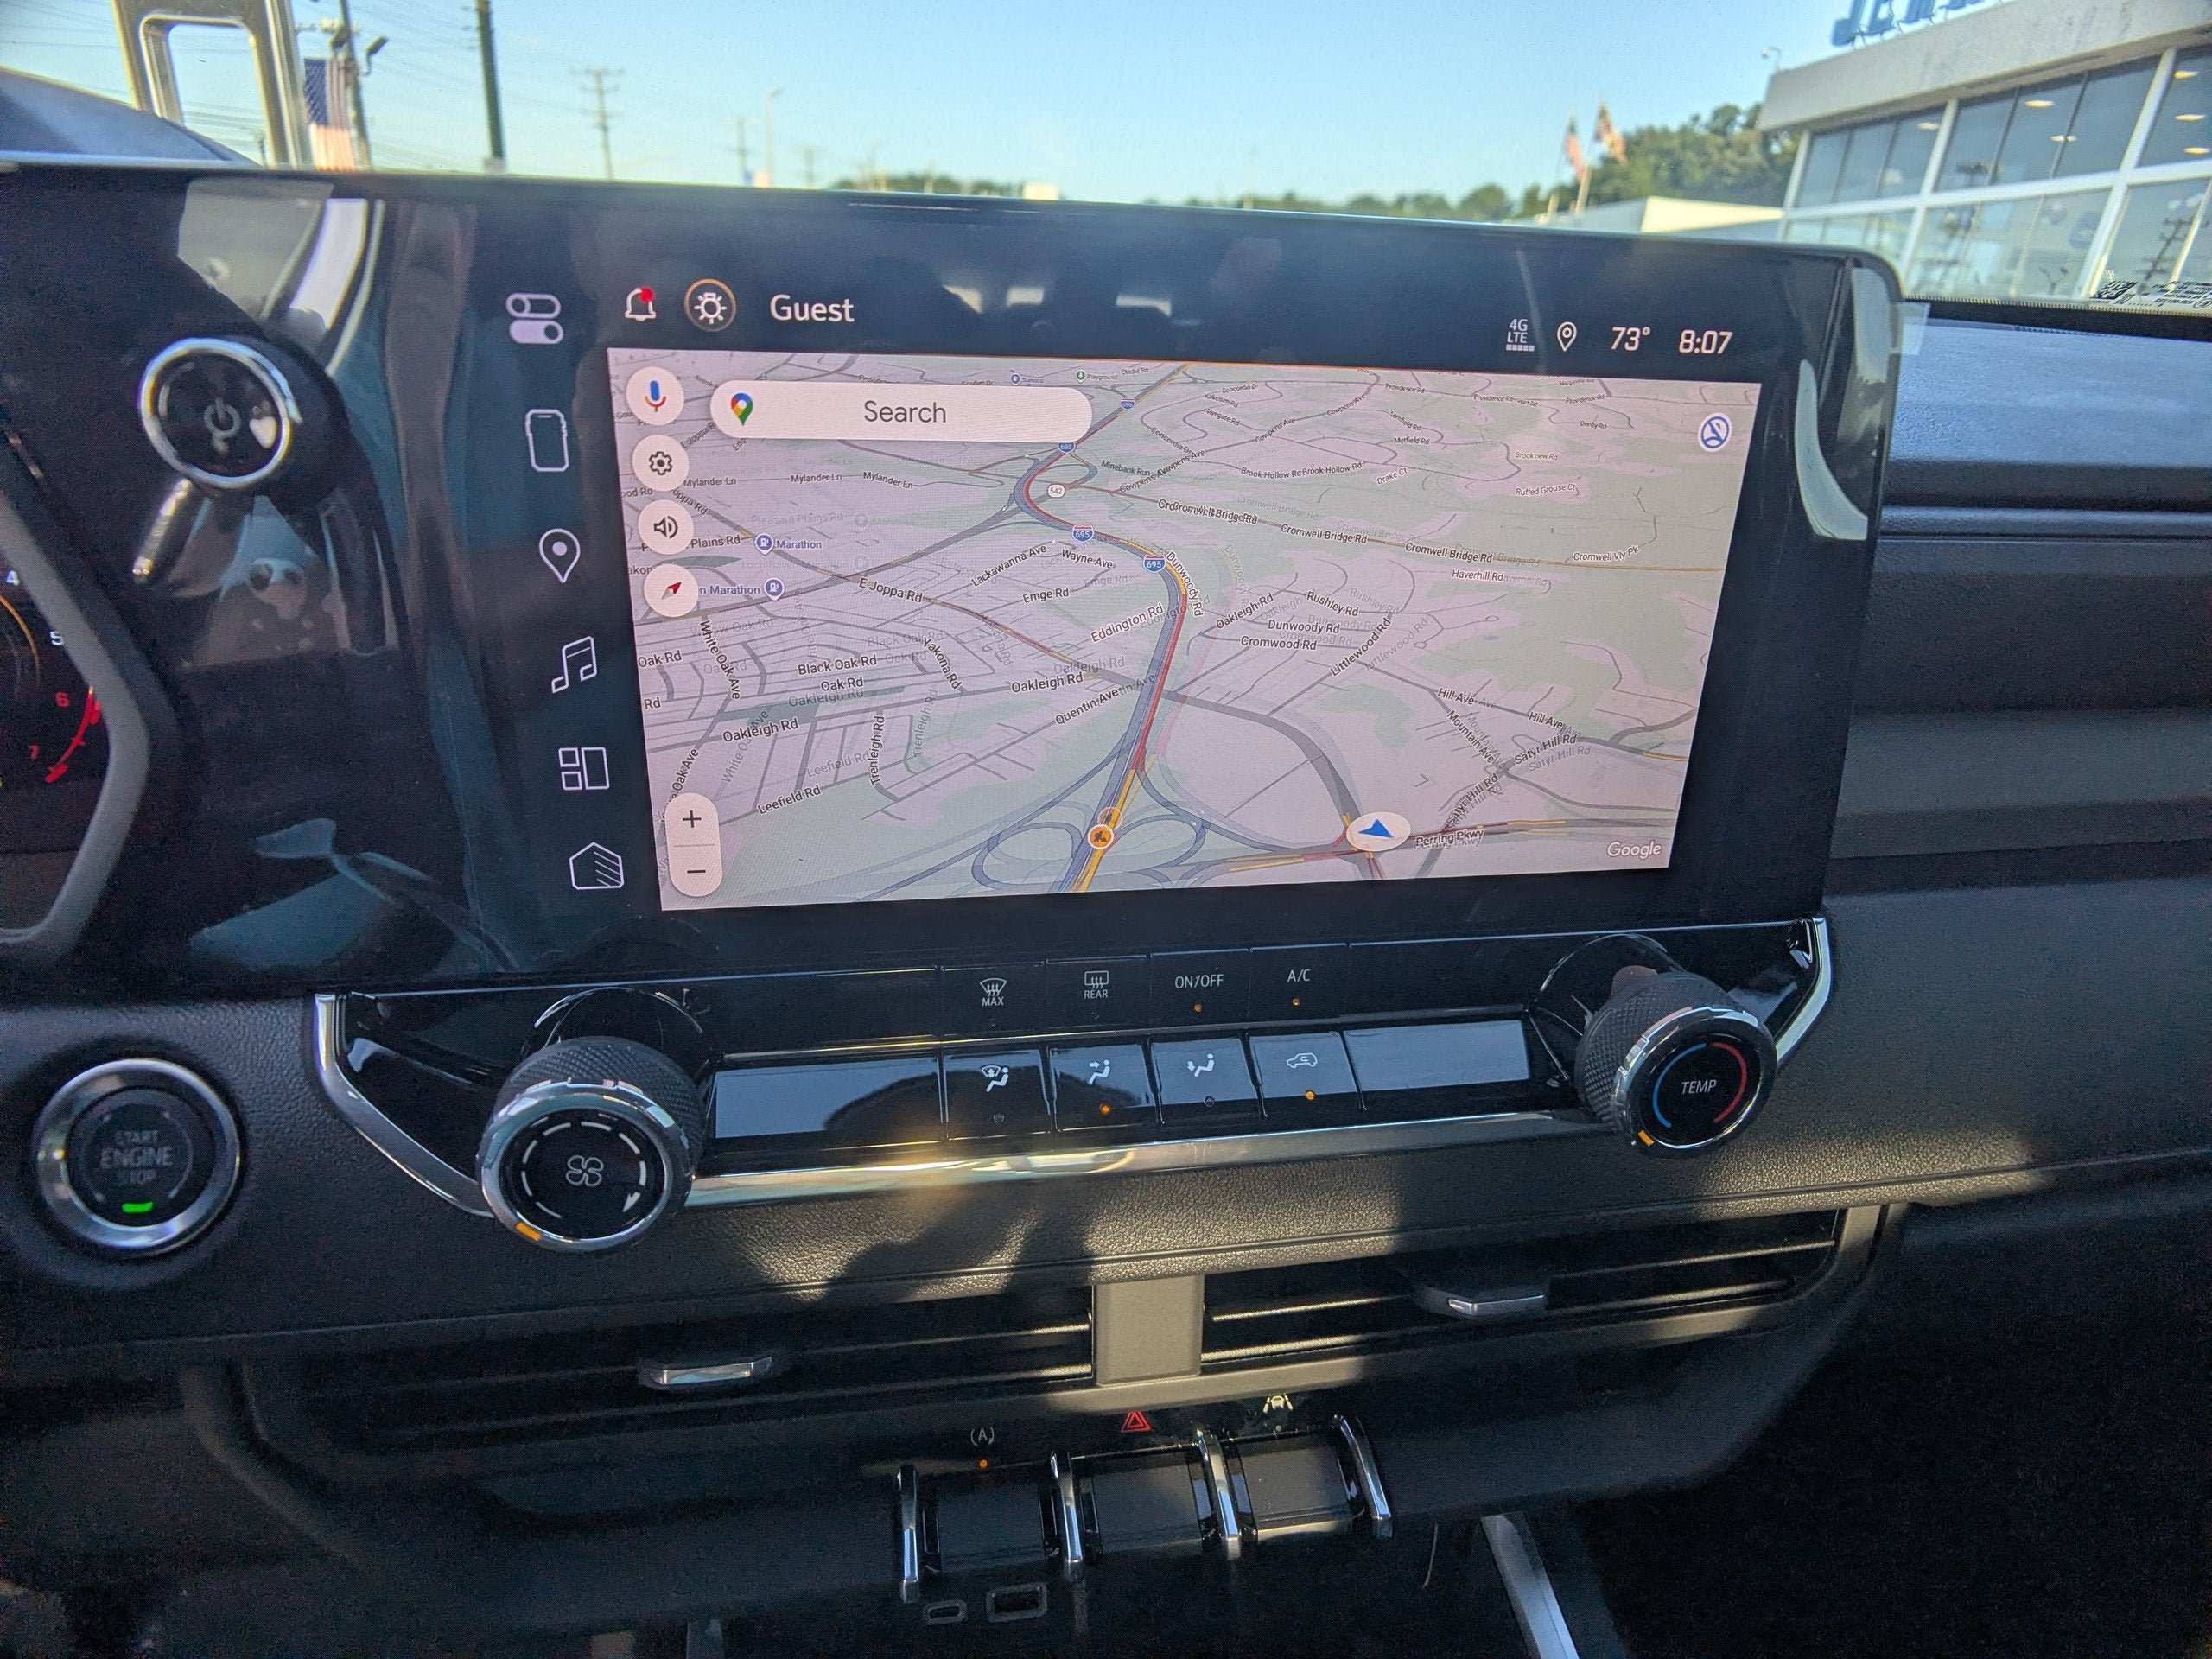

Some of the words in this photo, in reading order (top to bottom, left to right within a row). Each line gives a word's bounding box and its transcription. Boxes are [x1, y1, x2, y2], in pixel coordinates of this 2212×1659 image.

[770, 294, 855, 322] Guest
[1510, 319, 1528, 331] 4G
[1507, 332, 1527, 343] LTE
[1611, 327, 1650, 351] 73°
[1679, 330, 1732, 354] 8:07
[864, 400, 946, 423] Search
[1327, 399, 1354, 416] Cowpens
[1354, 394, 1367, 404] Ave
[1230, 417, 1240, 426] Rd
[1255, 423, 1283, 443] Cowpens
[1283, 417, 1297, 426] Ave
[1191, 449, 1205, 461] Ave
[1101, 460, 1135, 474] Minebank
[1136, 466, 1151, 476] Run
[1241, 467, 1262, 478] Brook
[1264, 469, 1290, 479] Hollow
[1291, 468, 1301, 477] Rd
[1302, 466, 1324, 476] Brook
[1325, 463, 1351, 474] Hollow
[1352, 461, 1363, 470] Rd
[1376, 473, 1397, 486] Drake
[1398, 467, 1408, 476] Ct
[683, 479, 722, 489] Mylander
[724, 477, 737, 486] Ln
[791, 473, 829, 484] Mylander
[830, 473, 843, 481] Ln
[863, 472, 902, 487] Mylander
[903, 480, 914, 489] Ln
[1120, 474, 1157, 493] Cowpens
[1049, 486, 1063, 495] 542
[1516, 486, 1540, 497] Ruffed
[1541, 484, 1567, 494] Grouse
[1567, 482, 1577, 492] Ct
[694, 499, 709, 514] Rd
[691, 537, 724, 549] Plains
[726, 535, 741, 545] Rd
[1281, 524, 1323, 539] Cromwell
[1324, 529, 1353, 543] Bridge
[1354, 532, 1368, 544] Rd
[777, 540, 822, 550] Marathon
[1405, 543, 1448, 558] Cromwell
[1449, 546, 1479, 563] Bridge
[1479, 551, 1493, 563] Rd
[1573, 552, 1611, 562] Cromwell
[1627, 546, 1640, 557] Pk
[971, 552, 1027, 588] Lackawanna
[1027, 545, 1047, 559] Ave
[1061, 548, 1093, 567] Wayne
[1094, 556, 1114, 571] Ave
[7, 570, 20, 586] 4
[1166, 551, 1198, 604] Dunwoody
[1192, 601, 1204, 617] Rd
[1451, 569, 1491, 582] Haverhill
[1491, 570, 1504, 582] Rd
[709, 585, 760, 595] Marathon
[859, 577, 868, 589] E
[868, 580, 906, 600] Joppa
[906, 590, 924, 603] Rd
[1023, 588, 1053, 604] Emge
[1054, 587, 1070, 599] Rd
[1216, 601, 1259, 629] Oakleigh
[1259, 592, 1274, 607] Rd
[1306, 590, 1343, 615] Rushley
[1344, 604, 1359, 617] Rd
[1090, 612, 1147, 643] Eddington
[1147, 602, 1164, 618] Rd
[1268, 619, 1324, 634] Dunwoody
[1325, 624, 1340, 634] Rd
[49, 631, 64, 645] 5
[1241, 635, 1300, 650] Cromwood
[1302, 639, 1317, 651] Rd
[1331, 632, 1379, 677] Littlewood
[1376, 617, 1392, 634] Rd
[638, 655, 664, 668] Oak
[664, 650, 682, 664] Rd
[700, 620, 719, 654] White
[716, 653, 734, 677] Oak
[728, 677, 741, 701] Ave
[798, 661, 831, 675] Black
[834, 658, 860, 671] Oak
[861, 654, 878, 668] Rd
[923, 638, 951, 678] Yakona
[946, 673, 963, 690] Rd
[821, 679, 845, 692] Oak
[847, 676, 864, 689] Rd
[1011, 677, 1065, 694] Oakleigh
[1066, 671, 1084, 685] Rd
[55, 692, 70, 708] 6
[644, 697, 661, 709] Rd
[1438, 687, 1454, 701] Hill
[1454, 693, 1475, 706] Ave
[1055, 698, 1098, 725] Quentin
[1098, 688, 1120, 705] Ave
[722, 721, 779, 743] Oakleigh
[779, 717, 800, 732] Rd
[874, 715, 886, 733] Rd
[1529, 711, 1545, 725] Hill
[1545, 716, 1564, 730] Ave
[1448, 709, 1481, 749] Mountain
[1478, 746, 1495, 765] Ave
[869, 732, 883, 787] Trenleigh
[1515, 747, 1542, 766] Satyr
[1542, 736, 1561, 751] Hill
[1561, 734, 1579, 746] Rd
[672, 767, 690, 792] Oak
[682, 748, 701, 771] Ave
[758, 790, 804, 815] Leefield
[804, 784, 822, 798] Rd
[1446, 796, 1469, 826] Satyr
[1466, 782, 1485, 803] Hill
[1484, 772, 1500, 789] Rd
[1415, 834, 1456, 849] Perring
[1456, 829, 1485, 842] Pkwy
[1607, 841, 1662, 860] Google
[1175, 974, 1224, 989] ON/OFF
[1287, 969, 1312, 983] A/C
[982, 996, 1005, 1007] MAX
[1084, 989, 1109, 1000] REAR
[1681, 1079, 1717, 1096] TEMP
[100, 1146, 174, 1170] ENGINE
